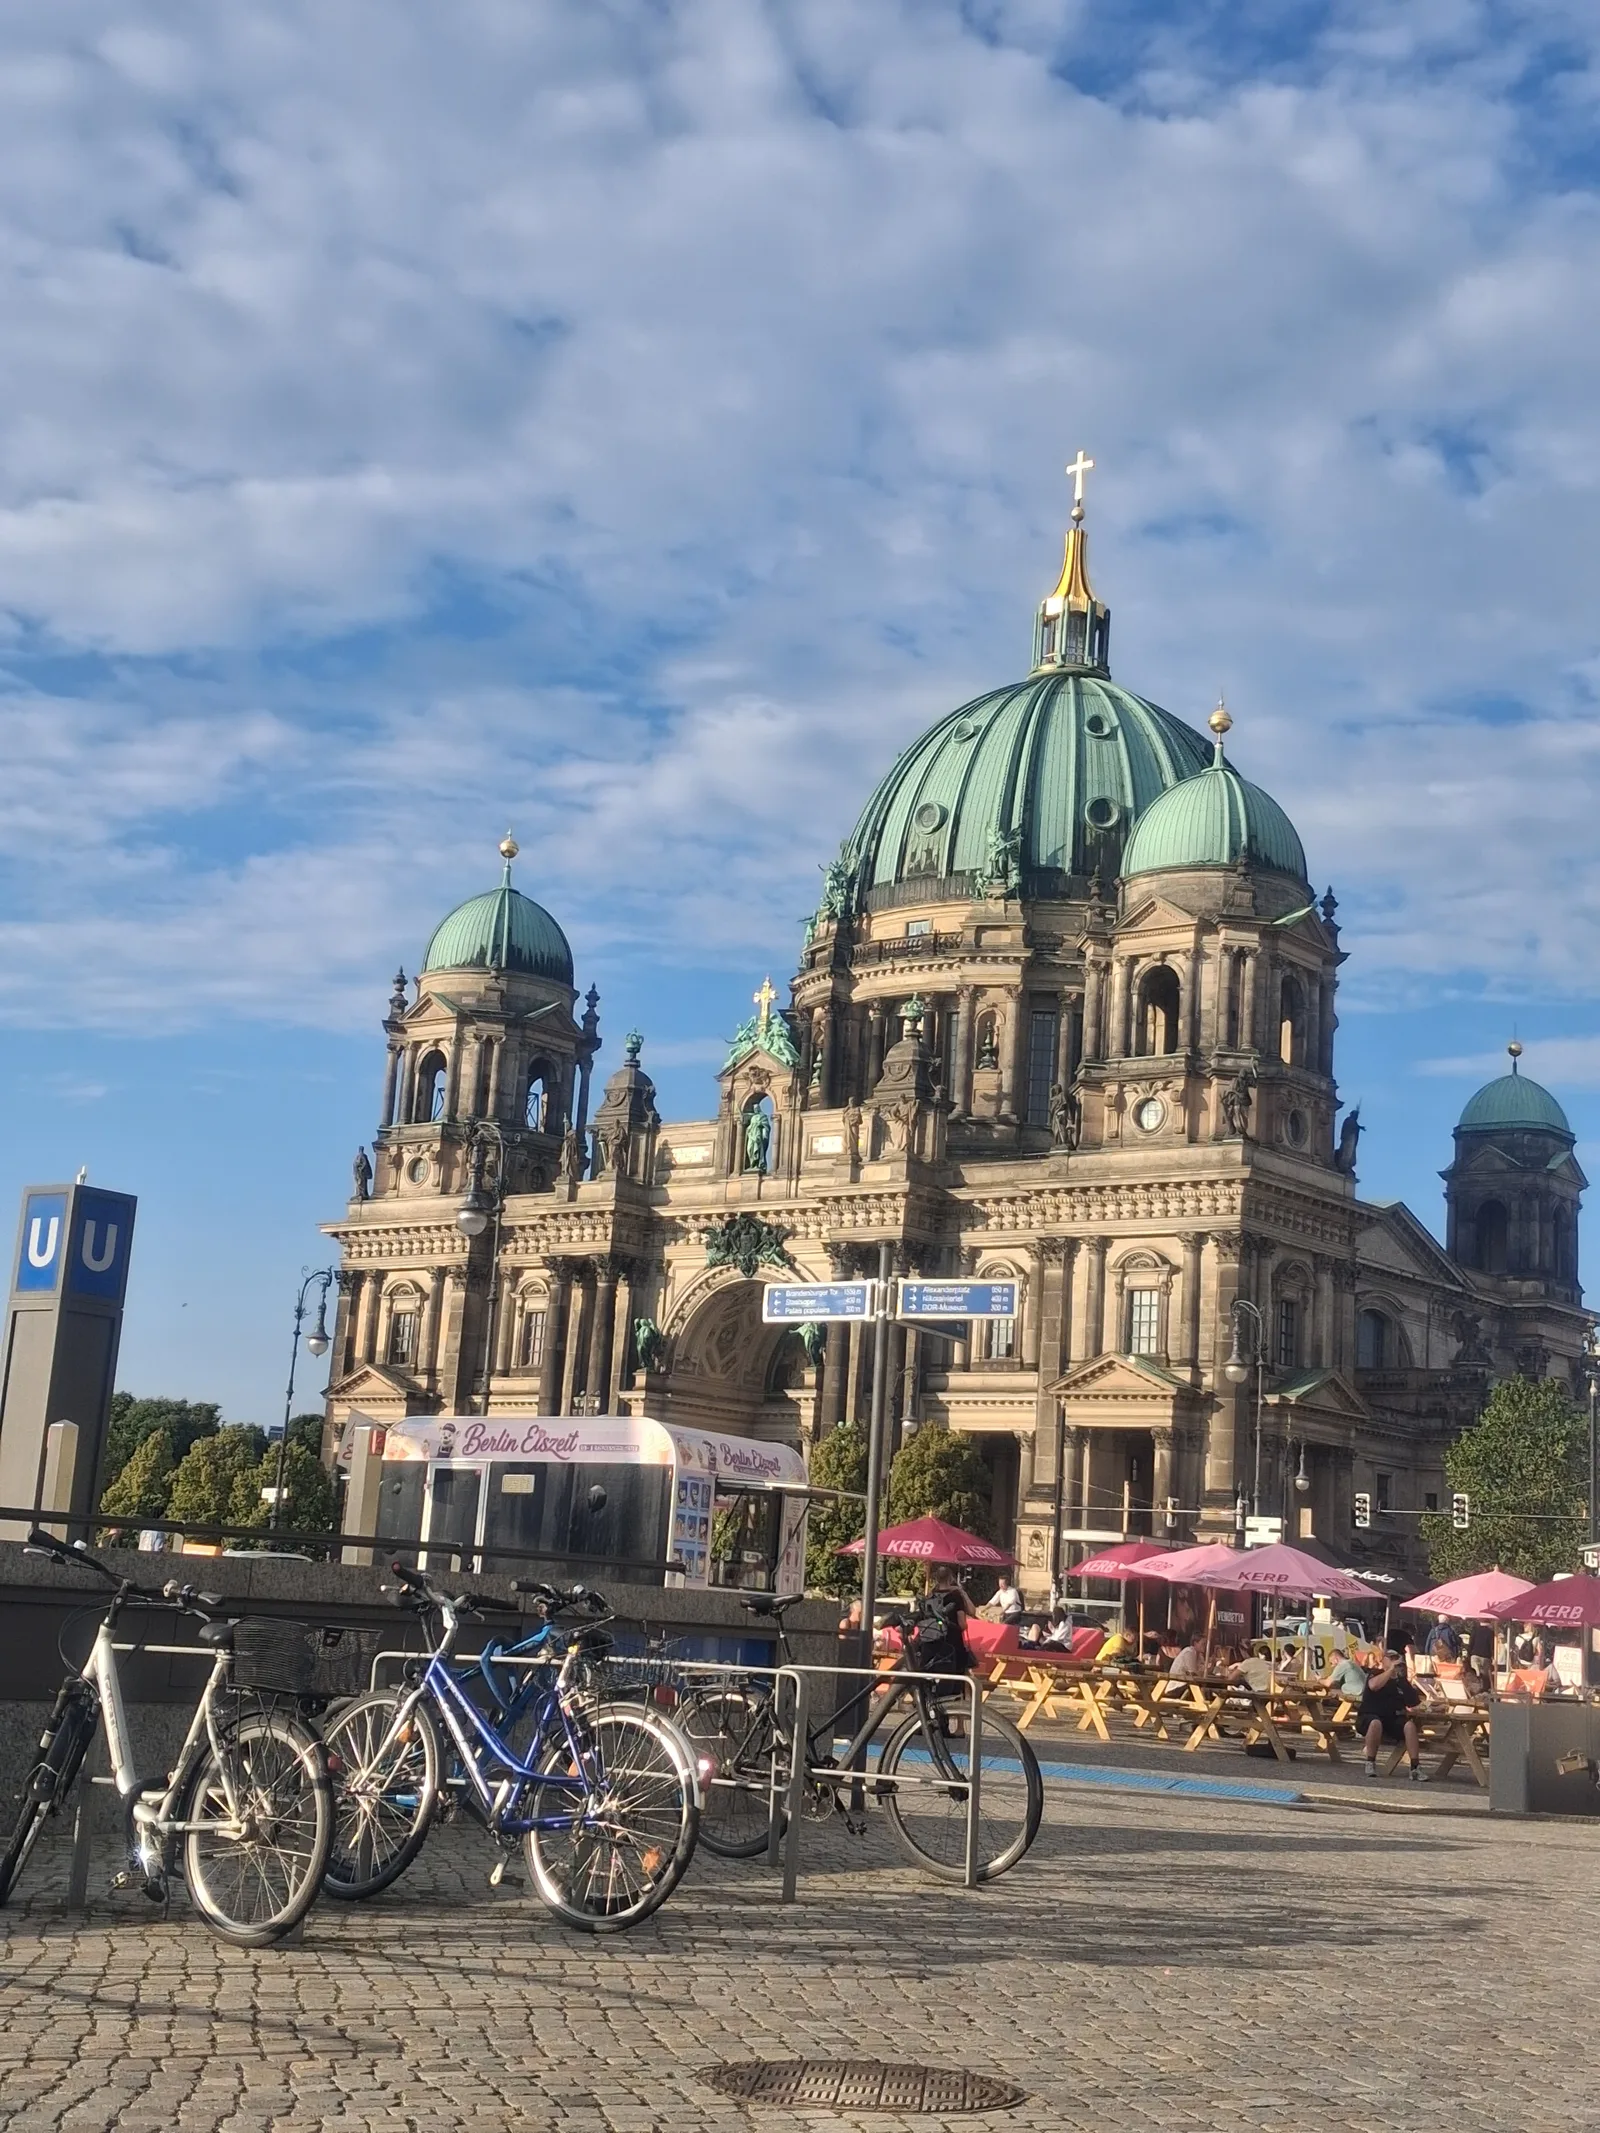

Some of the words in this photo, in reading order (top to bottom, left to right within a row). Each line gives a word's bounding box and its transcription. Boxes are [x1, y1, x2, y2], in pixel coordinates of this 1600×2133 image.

[27, 1217, 59, 1268] U
[81, 1220, 117, 1272] U
[785, 1289, 828, 1298] Brandenburger
[829, 1288, 838, 1296] Tor
[922, 1286, 971, 1295] Alexanderplatz
[922, 1294, 964, 1302] Nikolaiviertel
[785, 1307, 802, 1315] Palais
[922, 1303, 968, 1311] DDR-Museum
[462, 1423, 520, 1456] Berlin
[520, 1424, 580, 1461] Eiszeit
[719, 1442, 752, 1466] Berlin
[887, 1540, 934, 1555] KERB
[961, 1545, 1002, 1560] KERB
[1080, 1560, 1119, 1574] KERB
[1238, 1571, 1290, 1583] KERB
[1422, 1594, 1460, 1610] KERB
[1531, 1605, 1584, 1620] KERB
